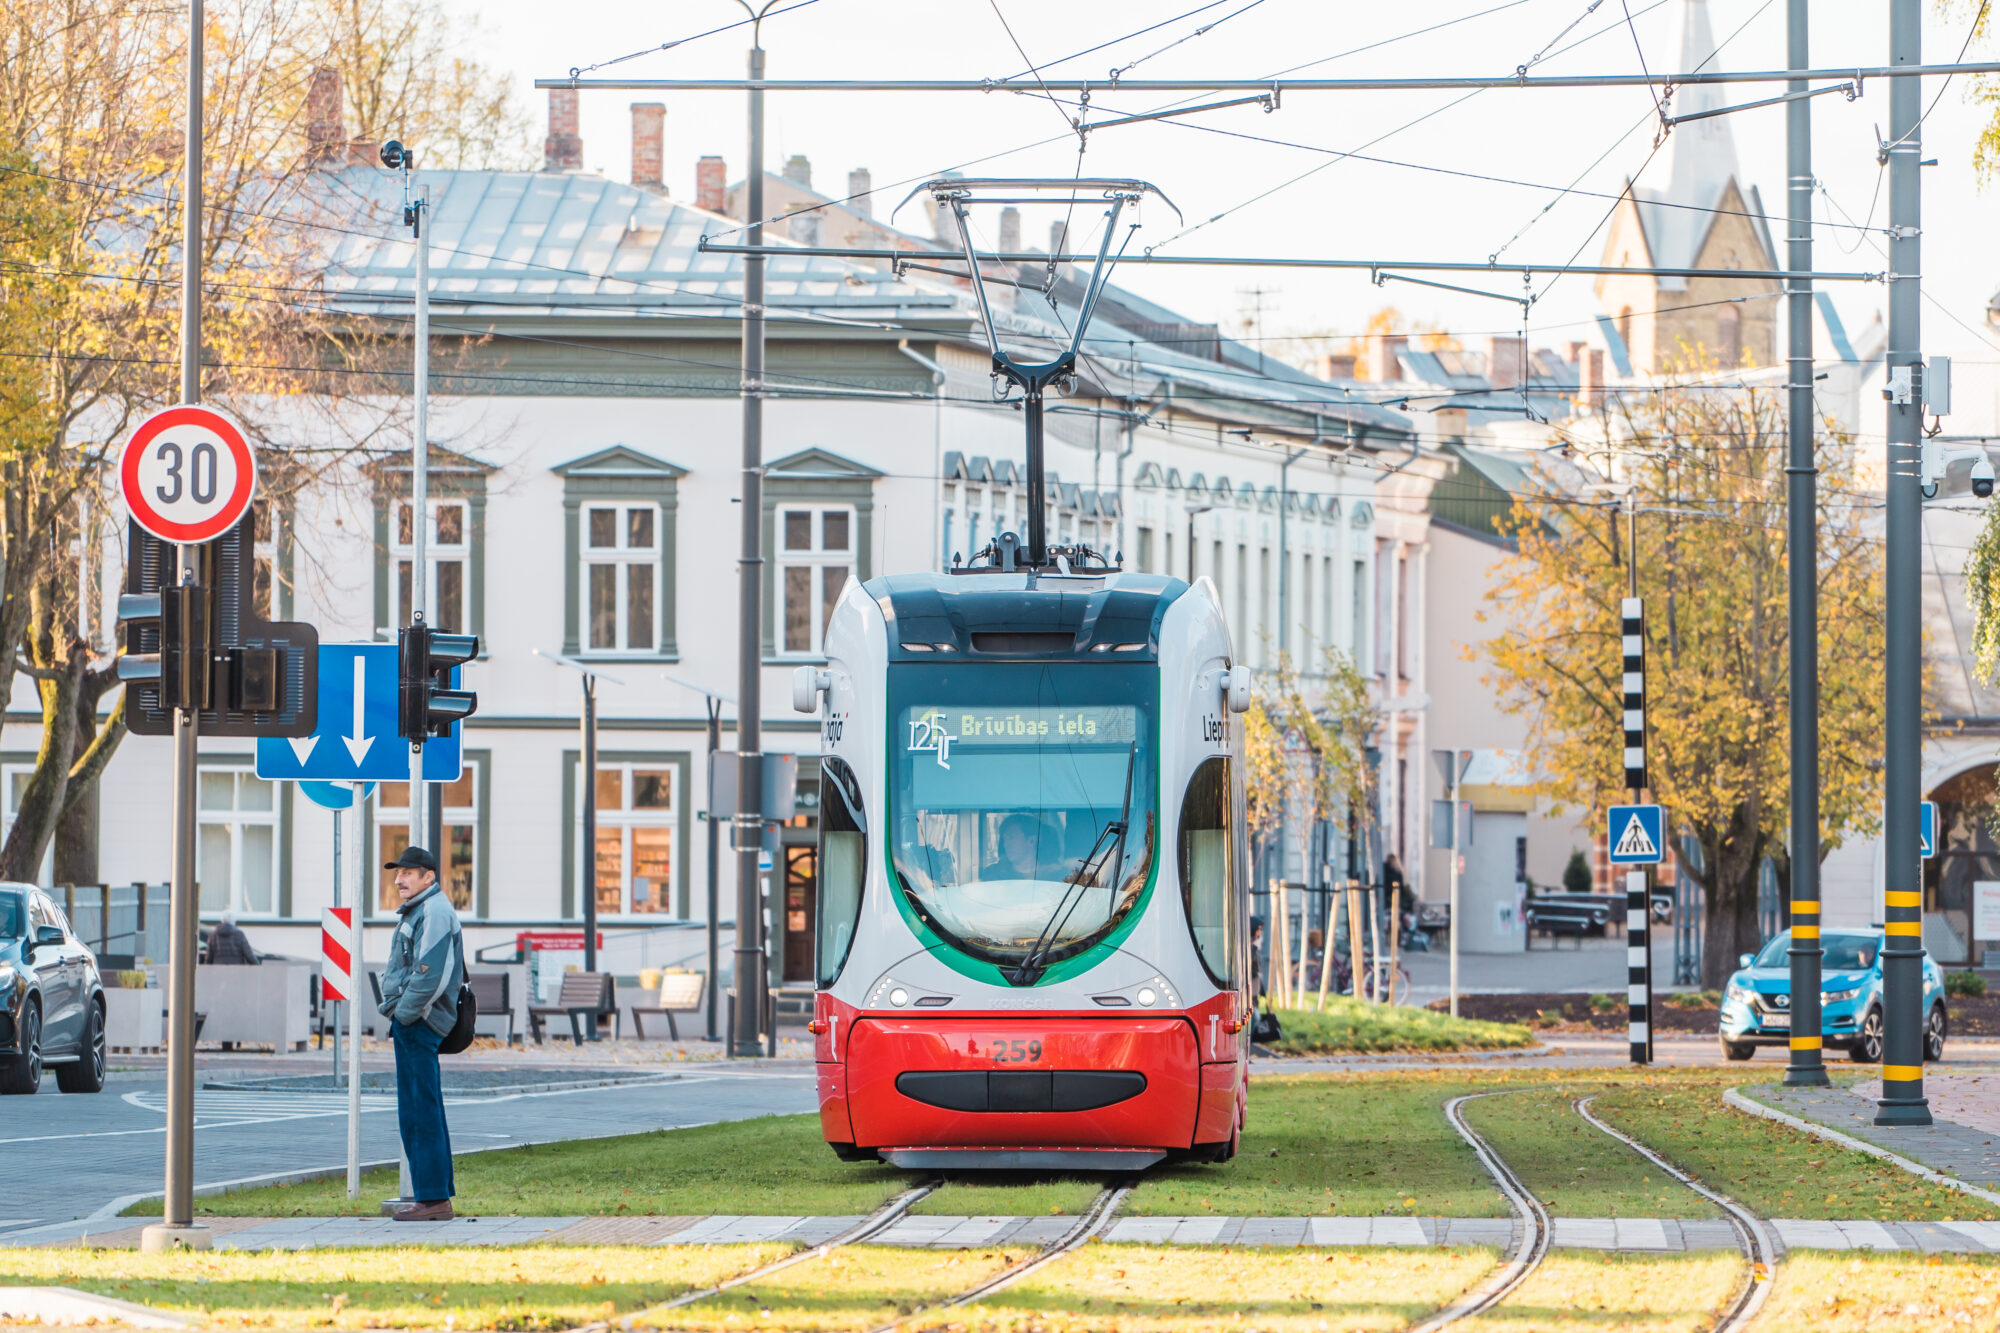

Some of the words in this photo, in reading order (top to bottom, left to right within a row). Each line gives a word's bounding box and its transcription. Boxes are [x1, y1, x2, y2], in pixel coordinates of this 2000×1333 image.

[157, 442, 217, 504] 30
[961, 714, 1049, 735] Brīvības
[1058, 713, 1096, 735] iela
[993, 1040, 1042, 1062] 259
